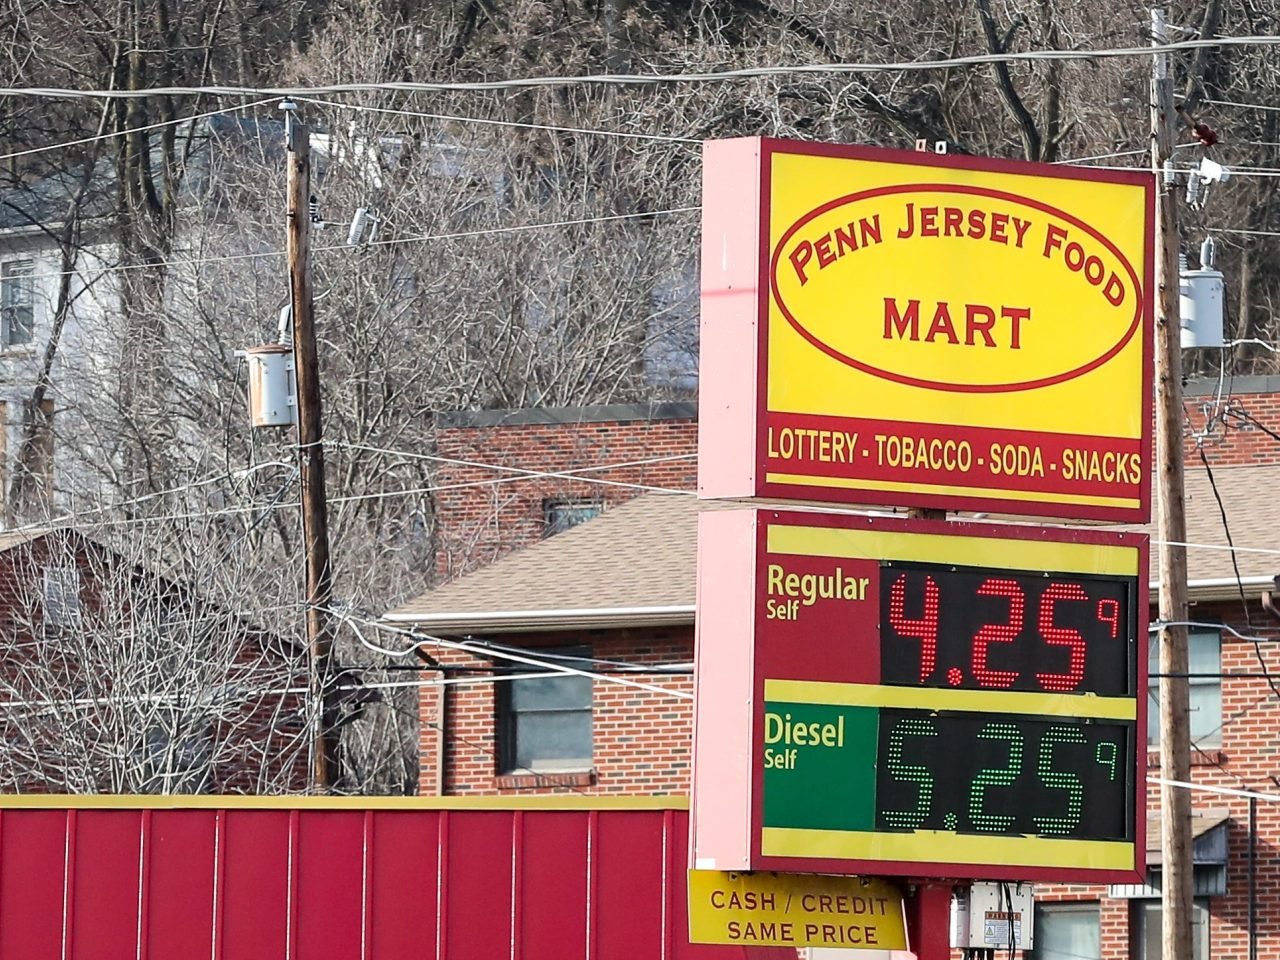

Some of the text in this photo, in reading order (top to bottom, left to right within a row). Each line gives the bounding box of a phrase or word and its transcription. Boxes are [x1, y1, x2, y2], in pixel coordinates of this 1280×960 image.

[788, 203, 1125, 308] PENN JERSEY FOOD
[883, 298, 1030, 349] MART
[767, 427, 859, 464] LOTTERY
[874, 435, 972, 472] TOBACCO
[989, 445, 1043, 477] SODA
[1062, 448, 1142, 485] SNACKS
[766, 564, 870, 606] Regular
[766, 599, 799, 621] Self
[888, 572, 1088, 691] 4.25
[764, 713, 844, 747] Diesel
[764, 749, 797, 770] Self
[882, 718, 1086, 835] 5.25
[710, 890, 775, 911] CASH
[801, 894, 888, 916] CREDIT
[727, 921, 878, 944] SAME PRICE
